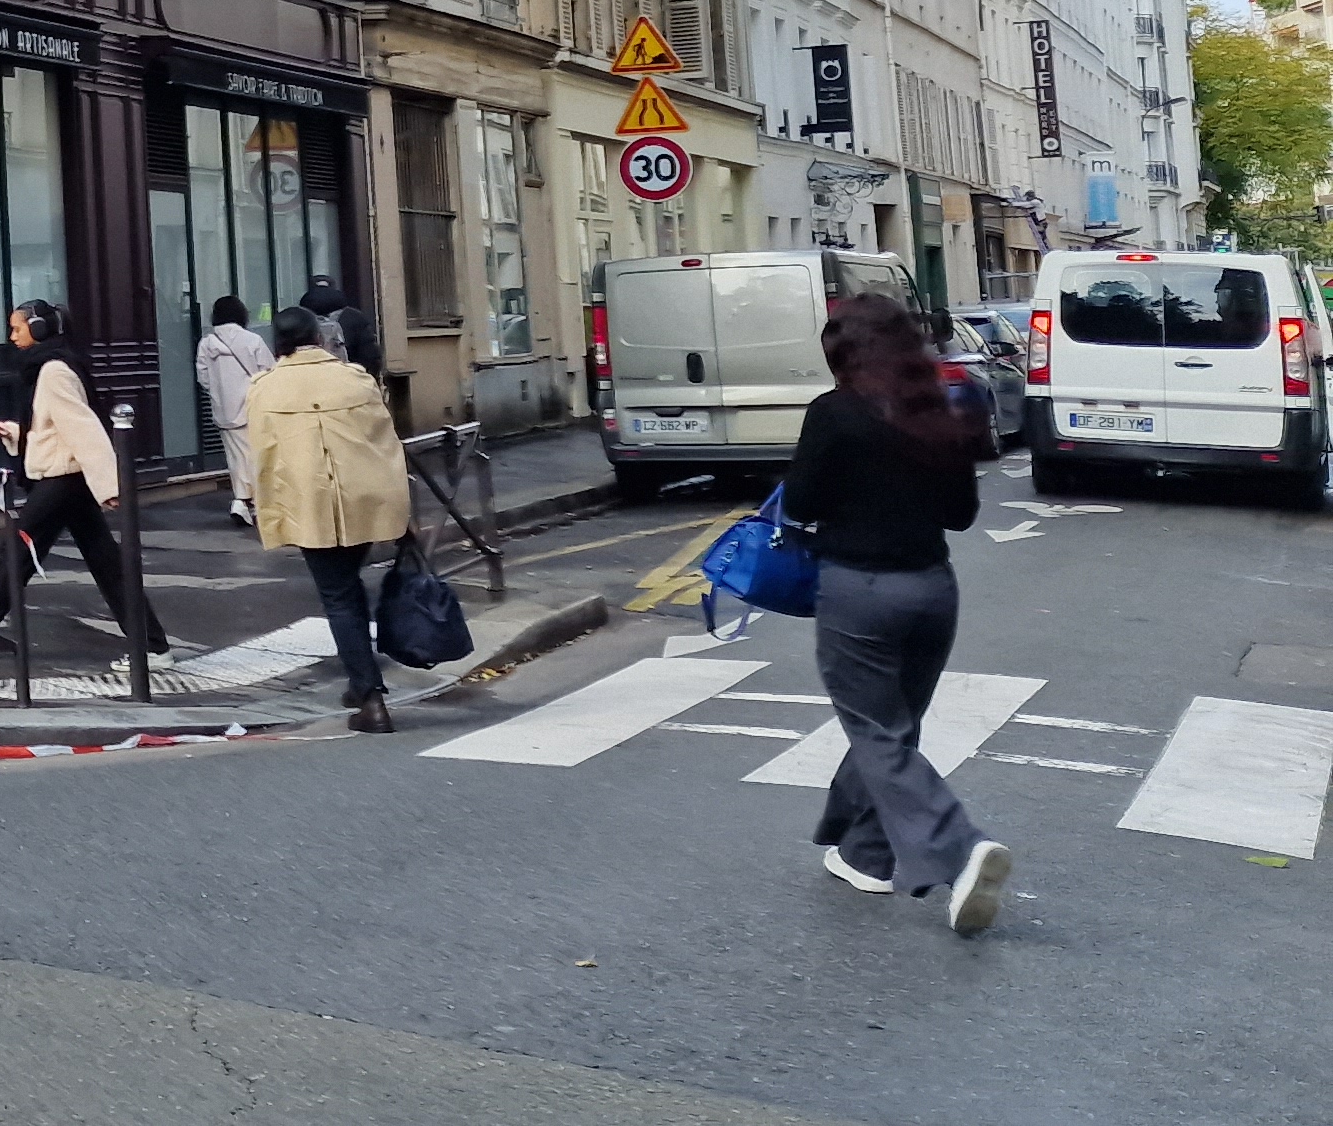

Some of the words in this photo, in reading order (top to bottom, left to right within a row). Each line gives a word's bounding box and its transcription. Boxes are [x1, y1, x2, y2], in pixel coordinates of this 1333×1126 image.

[17, 30, 81, 63] ARTISANALE
[1032, 22, 1053, 103] HOTEL
[632, 154, 677, 182] 30
